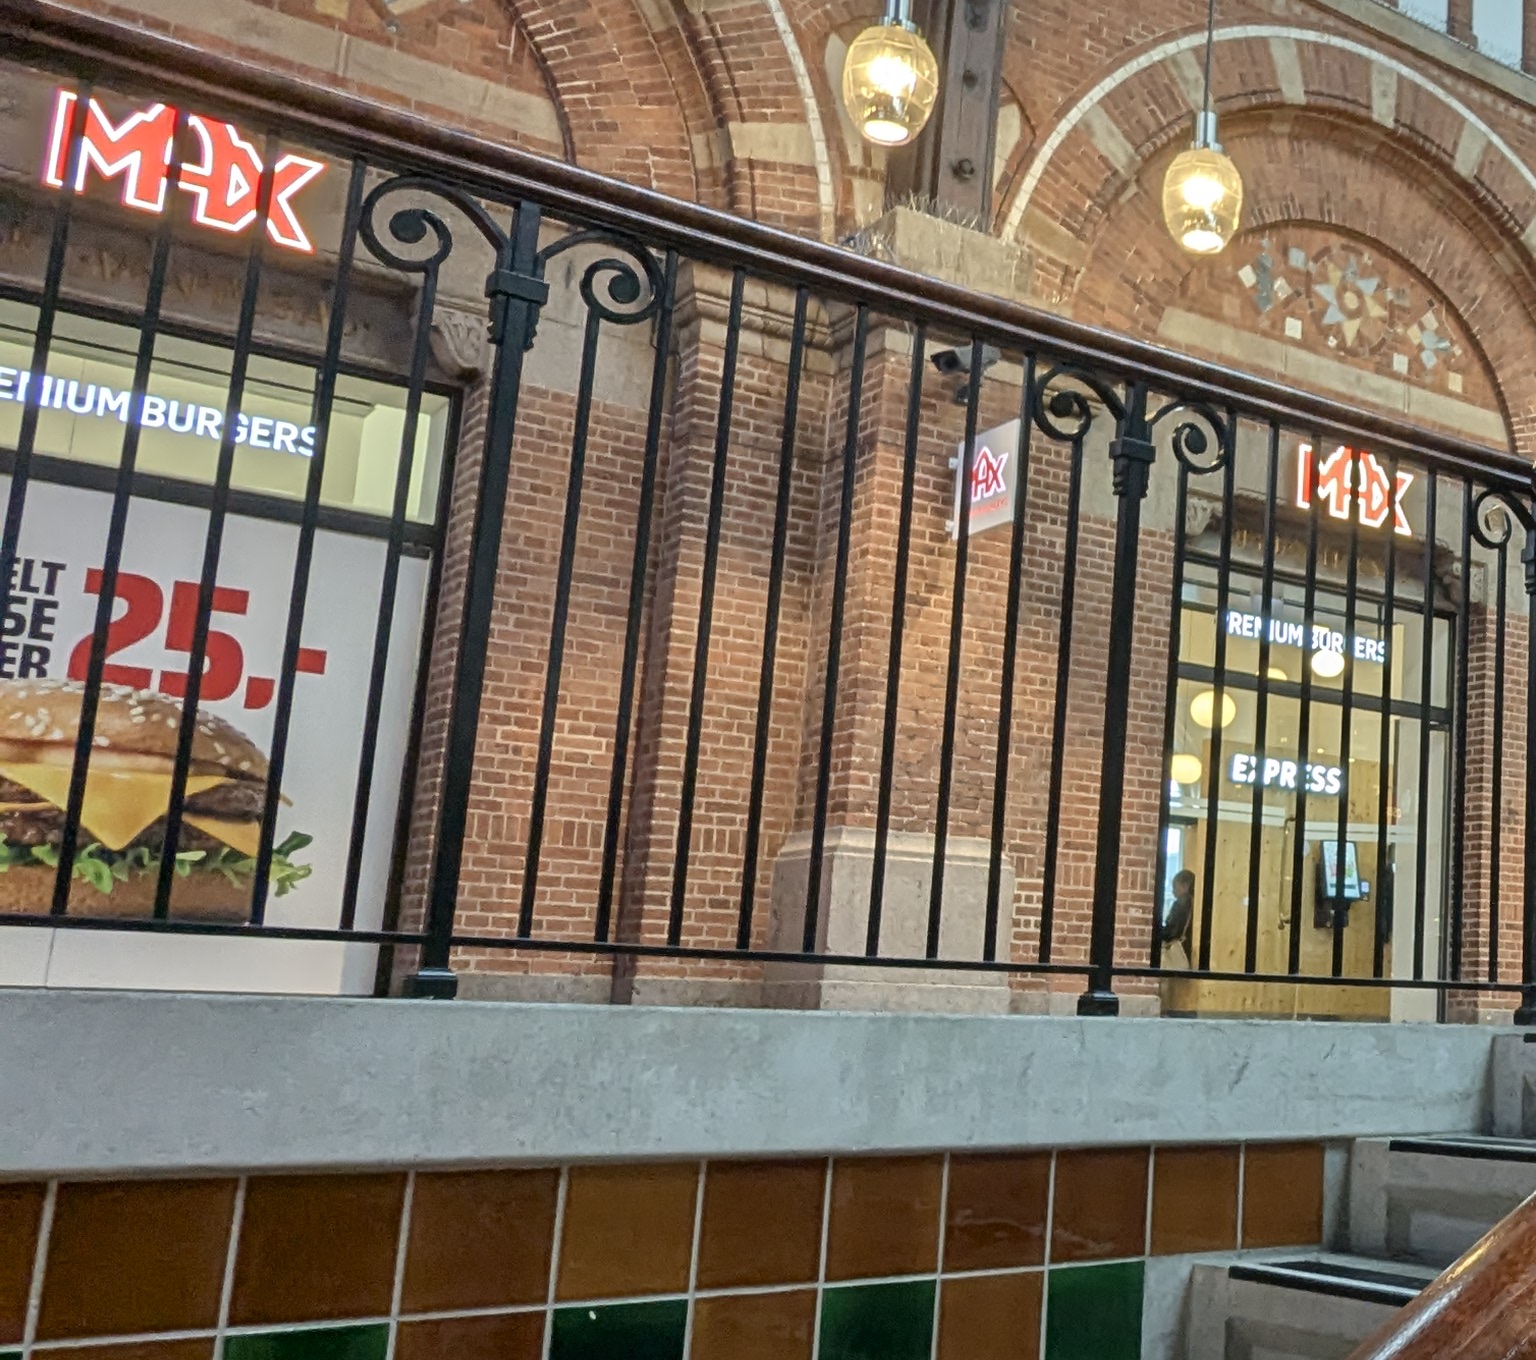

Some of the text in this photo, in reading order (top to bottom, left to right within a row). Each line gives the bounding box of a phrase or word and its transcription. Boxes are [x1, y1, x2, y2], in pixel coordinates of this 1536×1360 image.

[44, 89, 327, 254] MAX
[969, 445, 1010, 502] AX
[1226, 610, 1386, 664] REIUM URERS
[1232, 753, 1342, 795] EPRSS
